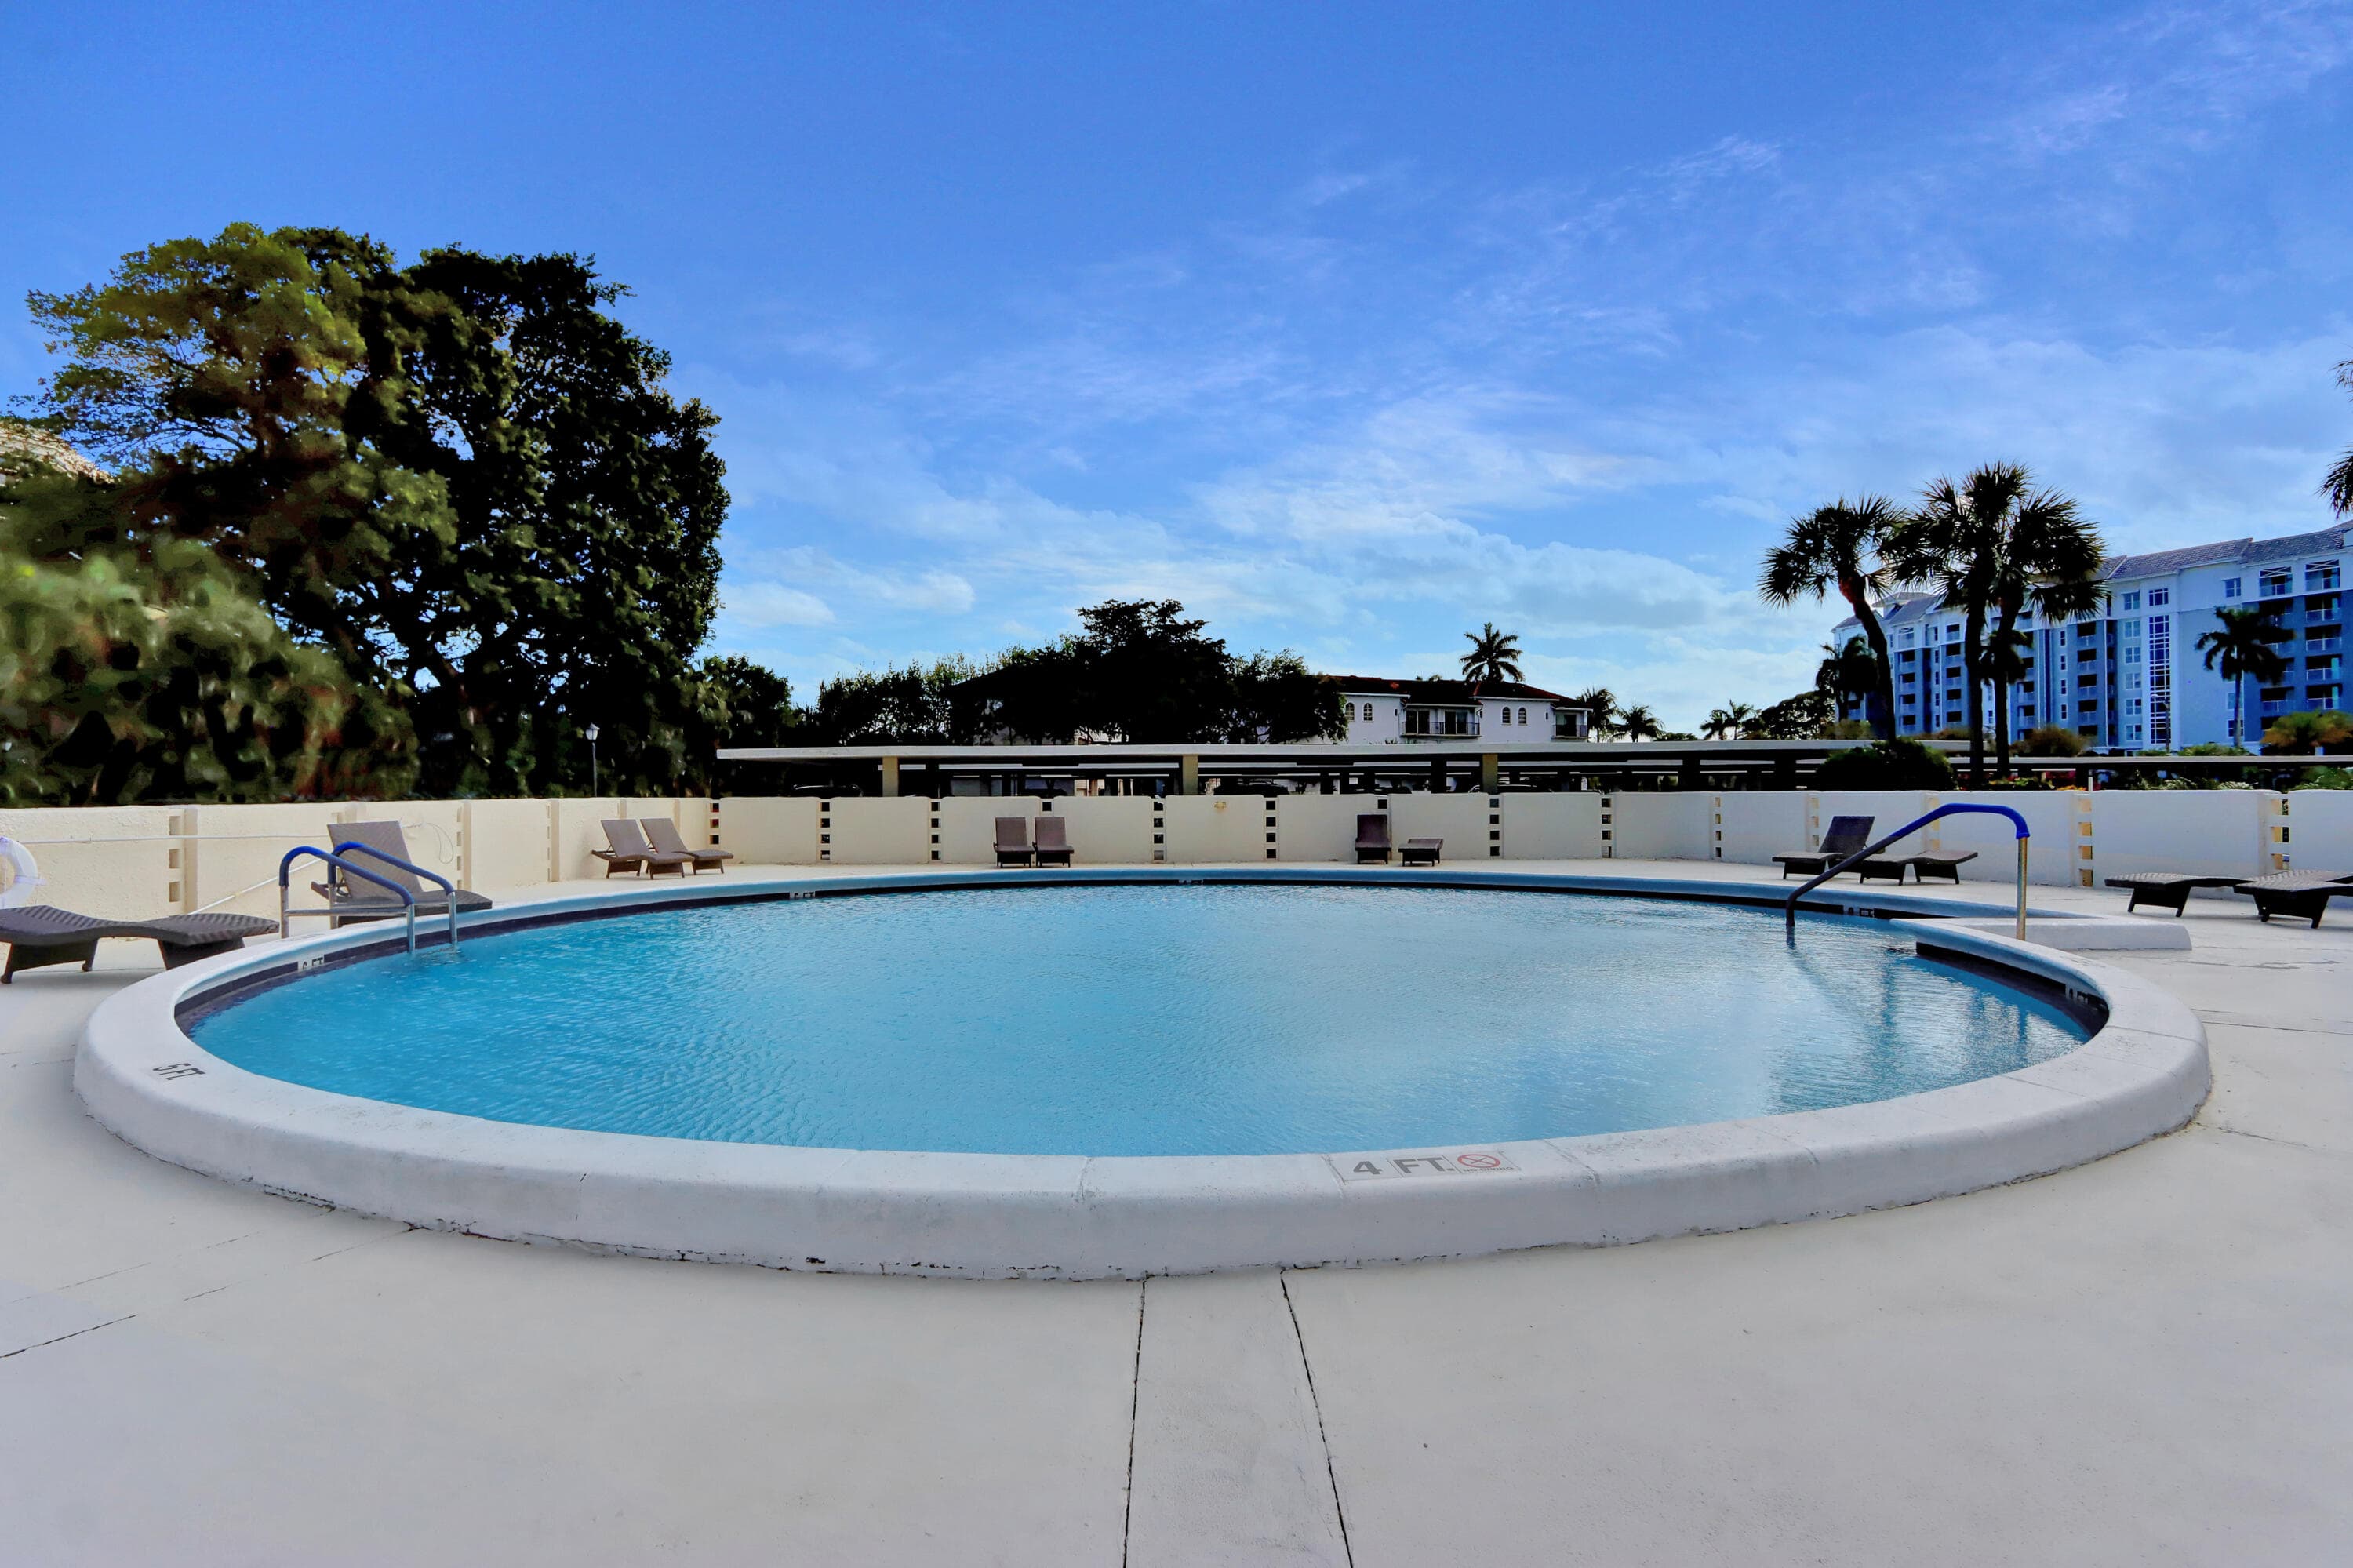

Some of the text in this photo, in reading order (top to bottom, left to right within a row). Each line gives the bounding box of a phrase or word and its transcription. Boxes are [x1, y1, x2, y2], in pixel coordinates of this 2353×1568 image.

[152, 1063, 206, 1081] 5 FT
[1352, 1156, 1456, 1175] 4 FT.
